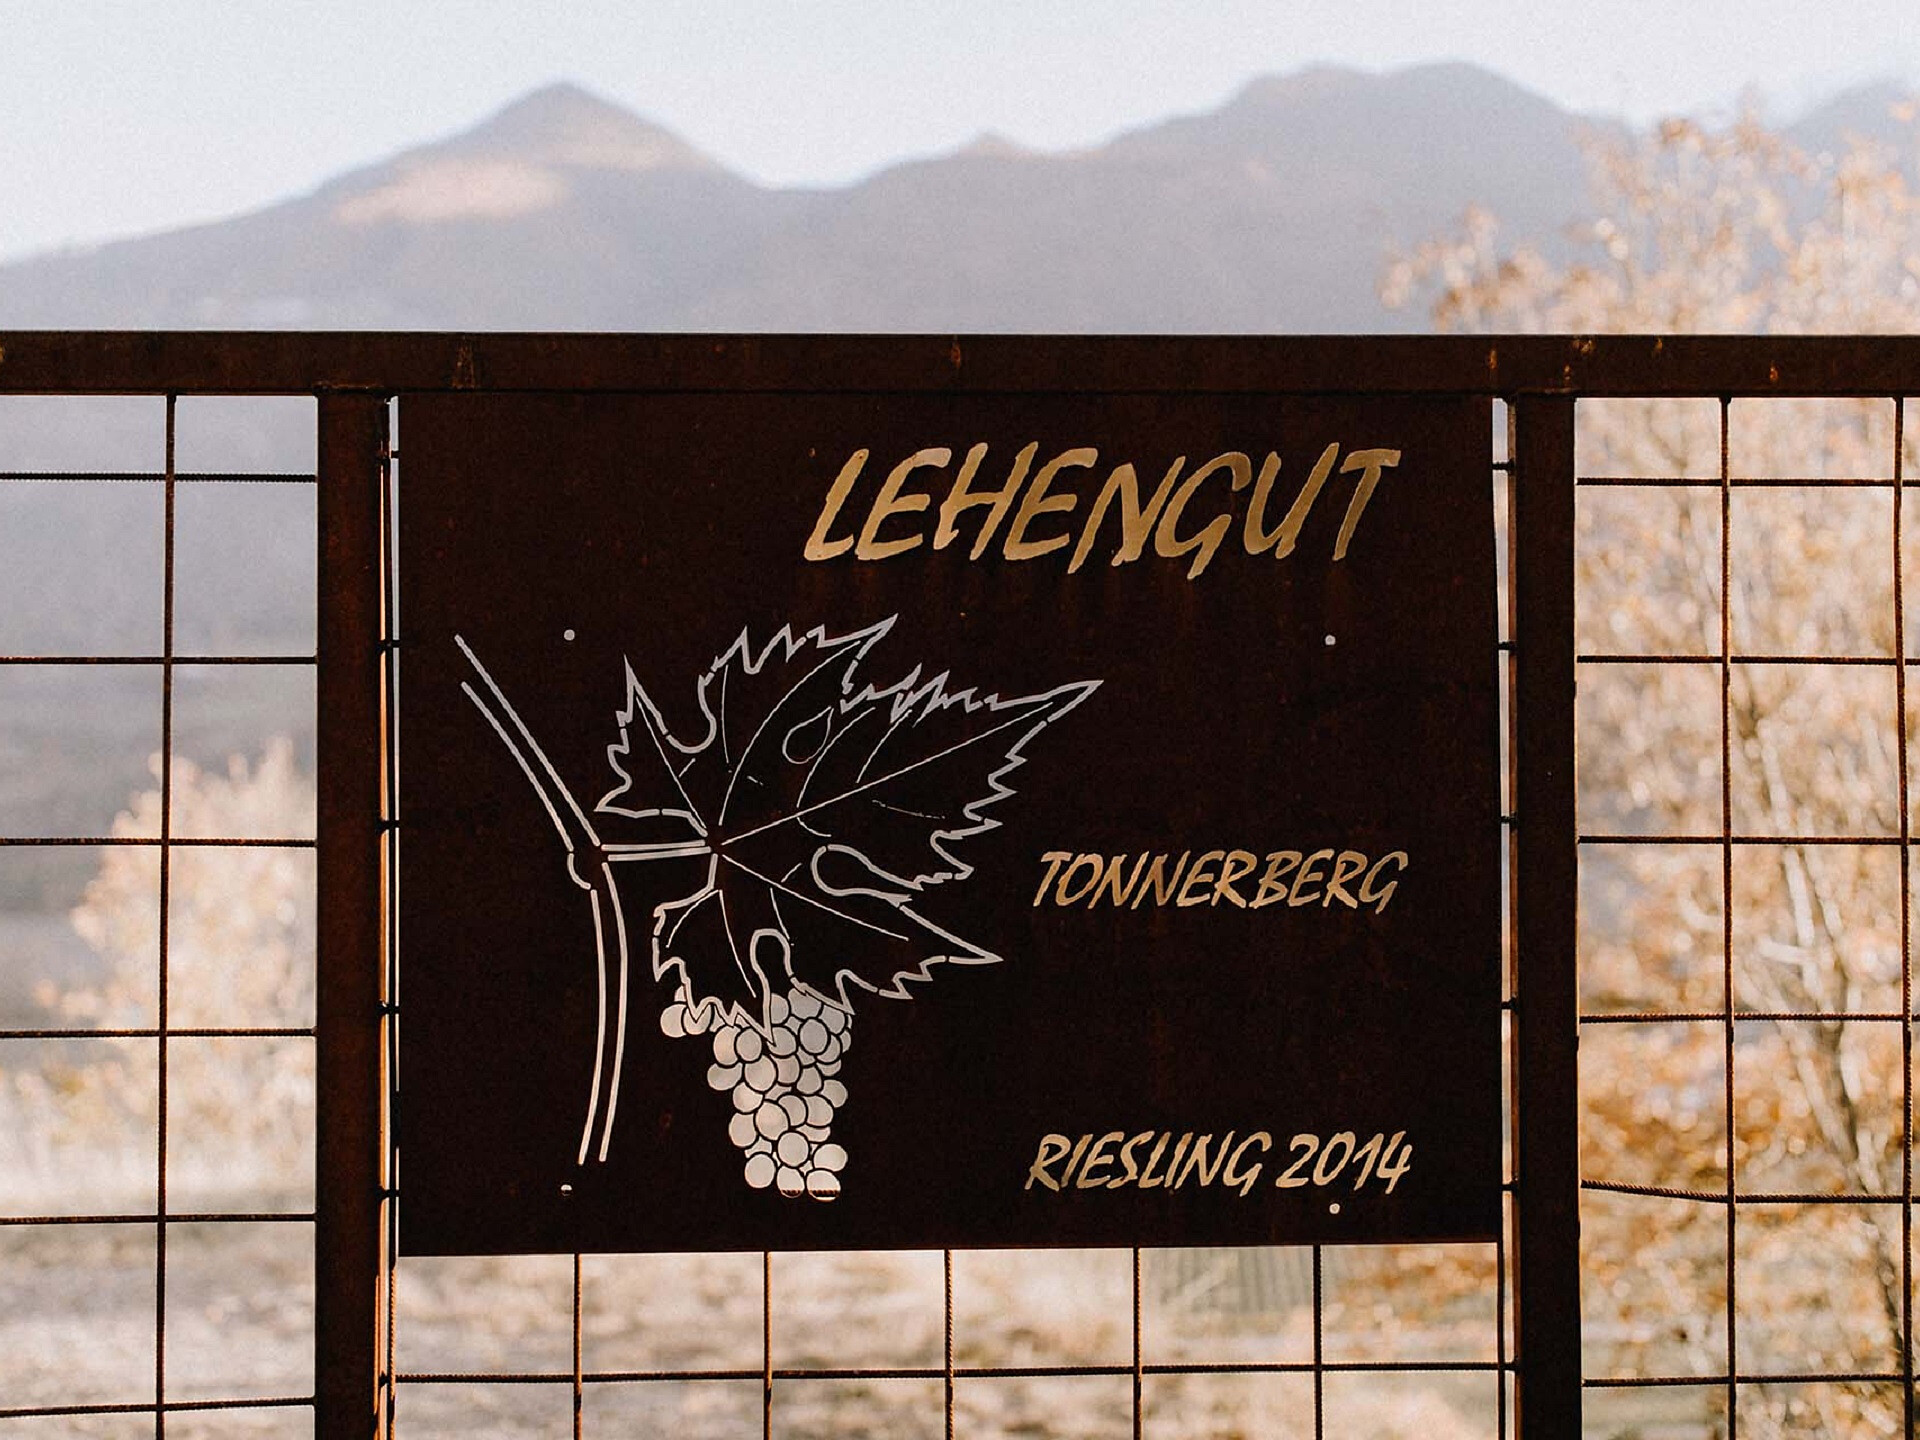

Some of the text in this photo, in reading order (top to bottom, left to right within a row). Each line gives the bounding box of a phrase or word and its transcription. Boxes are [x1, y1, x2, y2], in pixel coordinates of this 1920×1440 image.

[803, 440, 1402, 581] LEHENGUT
[1032, 849, 1409, 914] TONNERBERG
[1025, 1131, 1413, 1197] RIESLING 2014
